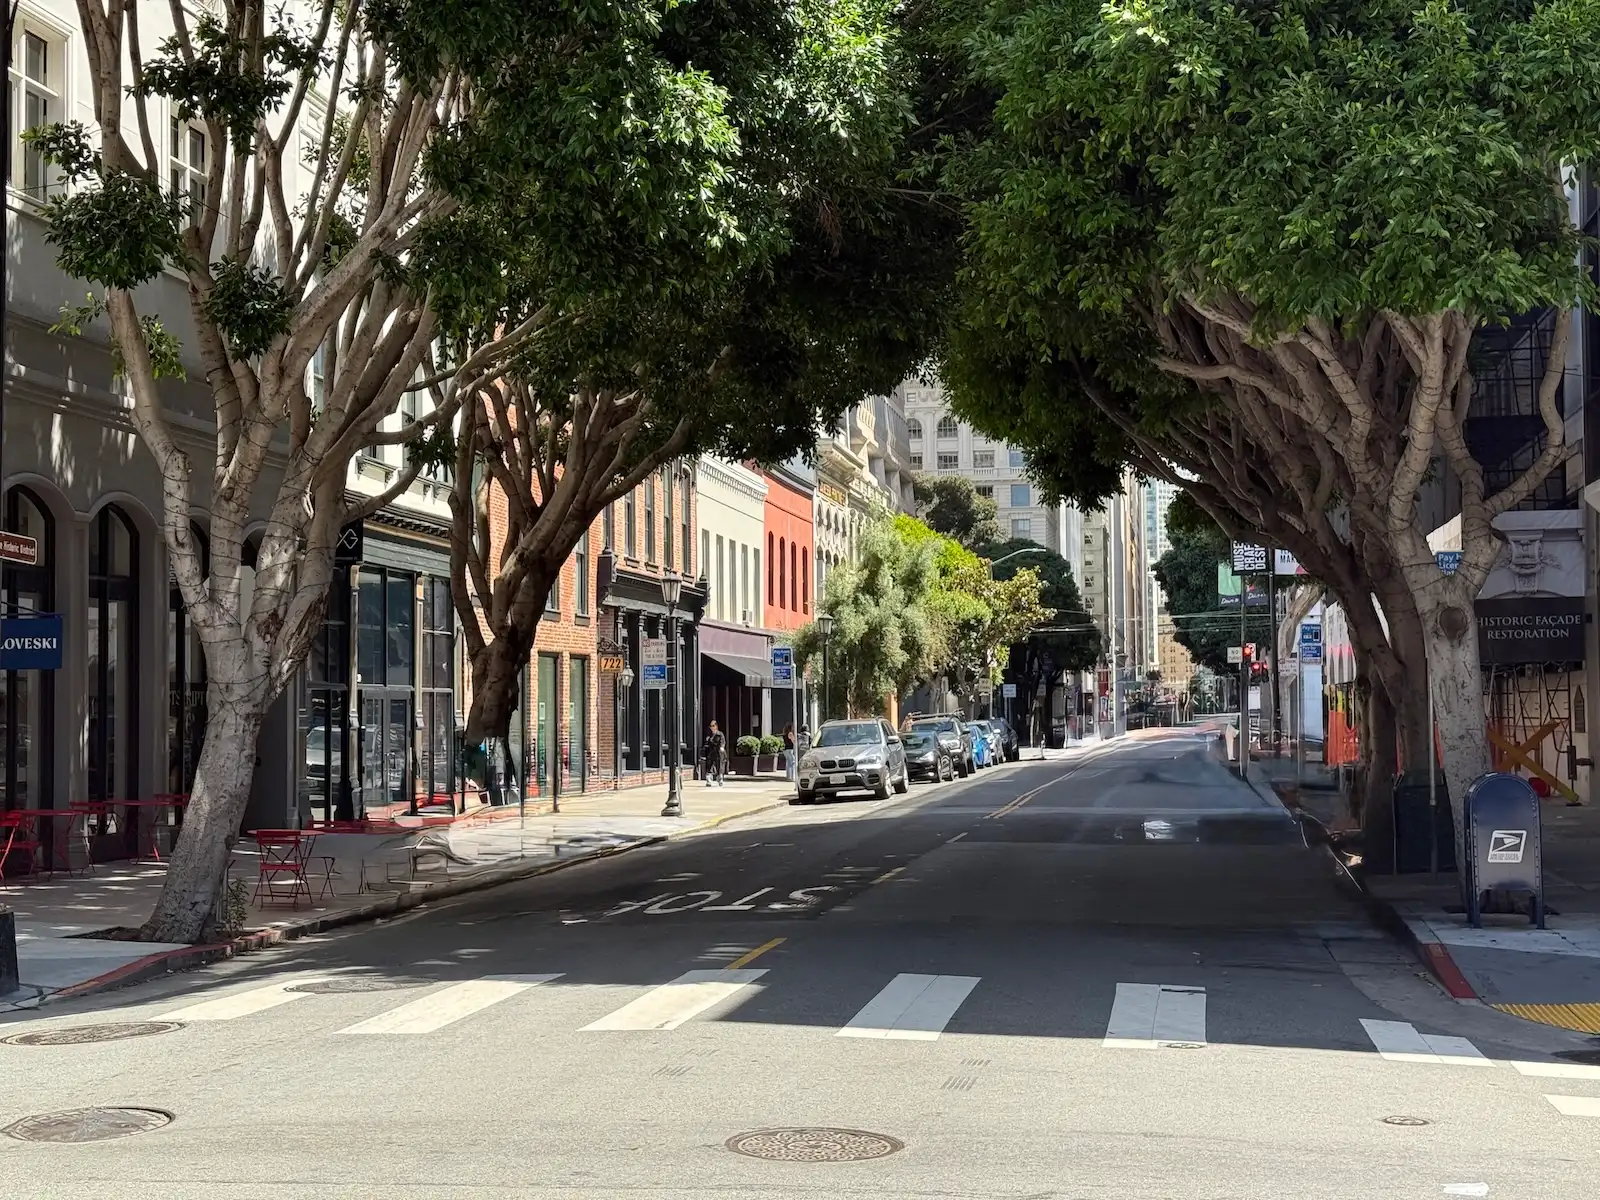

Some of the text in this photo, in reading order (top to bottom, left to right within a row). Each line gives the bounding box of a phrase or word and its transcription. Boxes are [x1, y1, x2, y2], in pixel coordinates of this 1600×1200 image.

[1233, 540, 1244, 571] MUSE
[1254, 544, 1266, 570] DESI
[1438, 553, 1454, 563] Pay
[1476, 615, 1581, 627] HISTORIC FAÇADE
[1487, 628, 1569, 640] RESTORATION
[603, 658, 622, 669] 722
